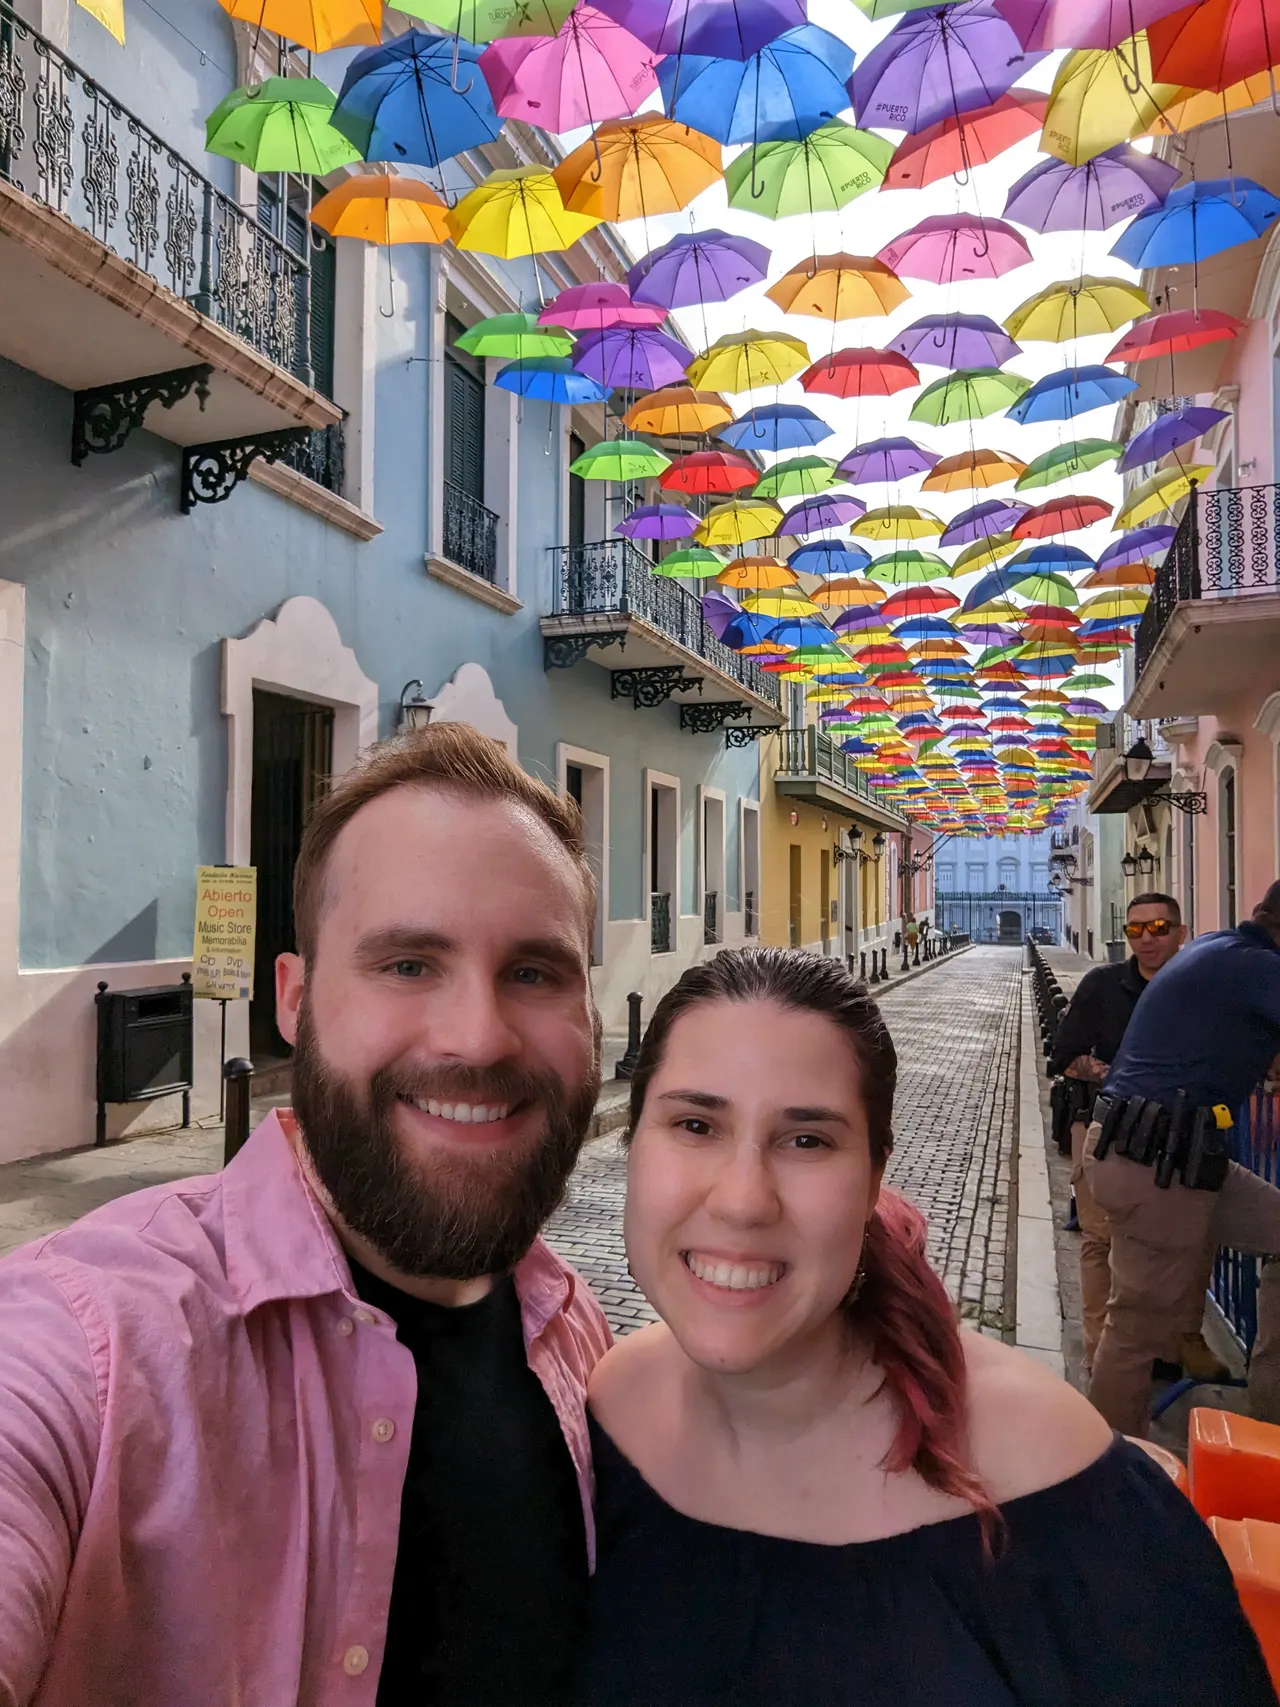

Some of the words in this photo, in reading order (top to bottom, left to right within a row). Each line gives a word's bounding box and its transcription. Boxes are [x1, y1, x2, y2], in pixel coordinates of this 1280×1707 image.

[876, 103, 908, 114] #PUERTO
[889, 113, 906, 122] RICO
[841, 171, 868, 192] #PUERTO
[856, 176, 872, 189] RICO
[1111, 193, 1144, 211] #PUERTO
[1128, 199, 1146, 210] RICO
[202, 888, 252, 902] Abierto
[207, 905, 244, 920] Open
[198, 921, 225, 933] Music
[227, 921, 252, 934] Store
[202, 935, 247, 946] Memorabilia
[200, 954, 216, 966] CD
[226, 956, 243, 968] DVD
